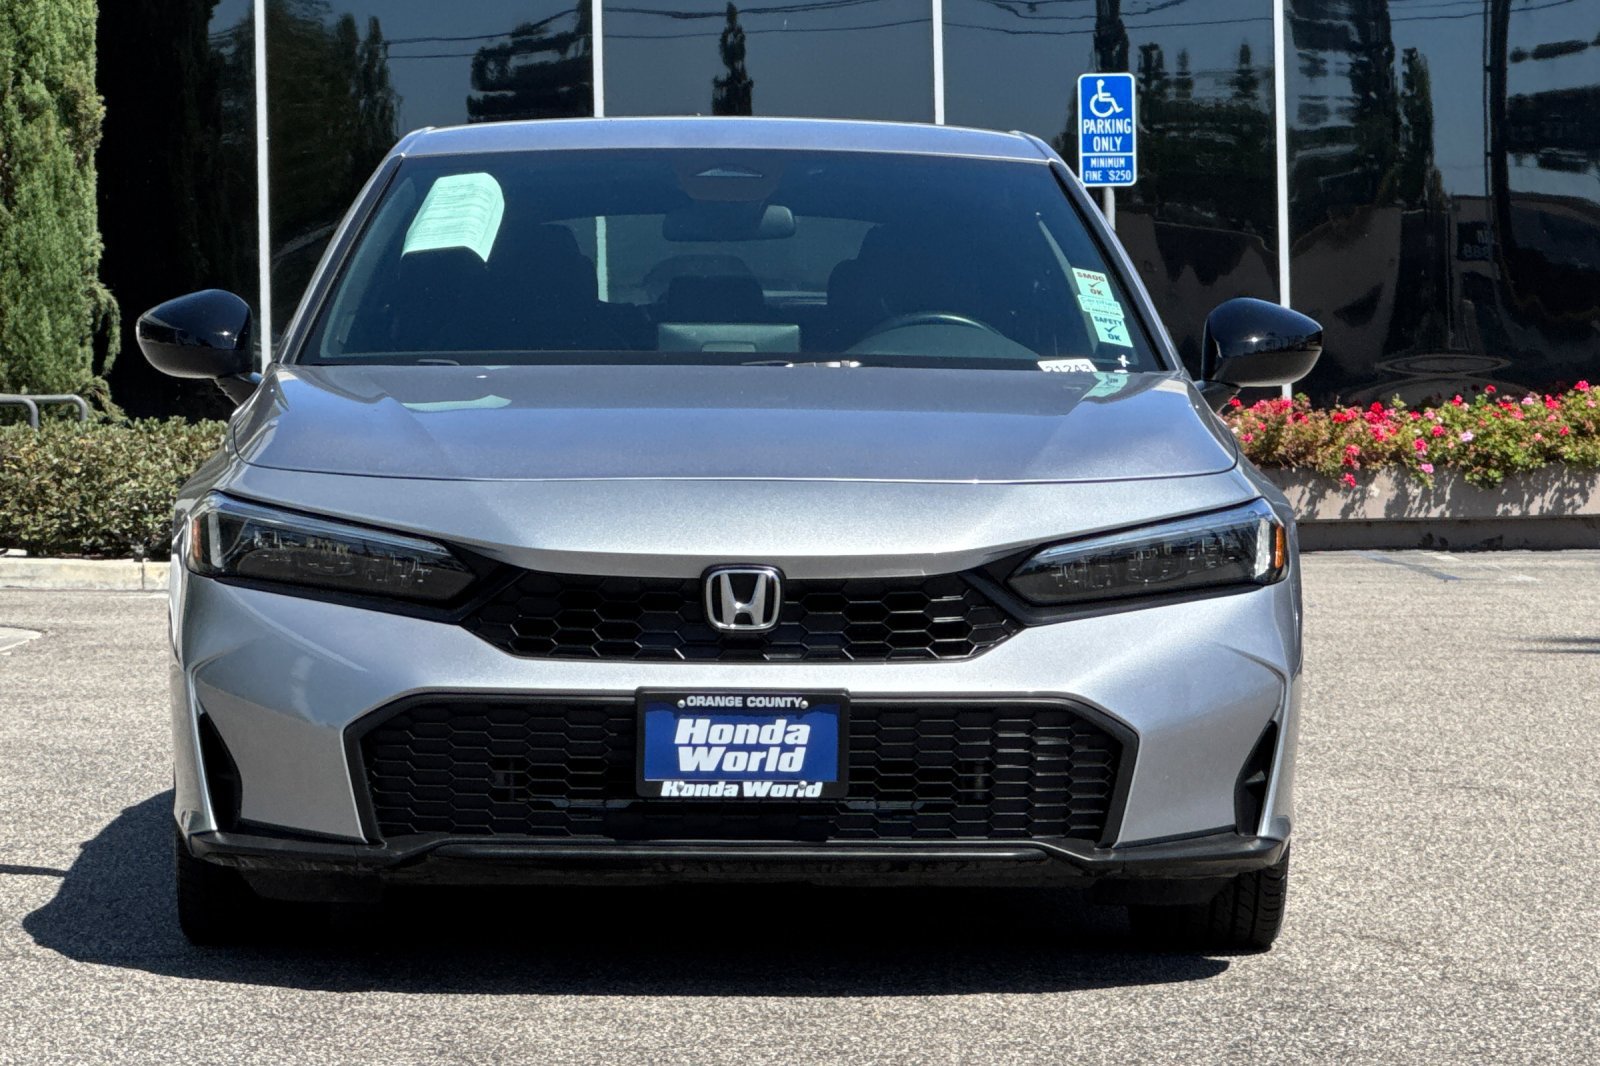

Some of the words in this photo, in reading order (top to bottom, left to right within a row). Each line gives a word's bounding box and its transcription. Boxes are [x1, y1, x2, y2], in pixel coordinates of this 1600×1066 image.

[1083, 118, 1132, 135] PARKING
[1093, 136, 1123, 152] ONLY
[1090, 157, 1126, 169] MINIMUM
[1085, 170, 1103, 181] FINE
[1108, 169, 1132, 182] $250
[1077, 271, 1105, 283] SMOG
[1090, 288, 1104, 297] OK
[1094, 315, 1122, 326] SAFETY
[1107, 333, 1122, 342] OK
[686, 695, 743, 708] ORANGE
[746, 696, 803, 708] COUNTY
[674, 718, 811, 745] Honda
[678, 746, 807, 773] World
[660, 781, 739, 797] Honda
